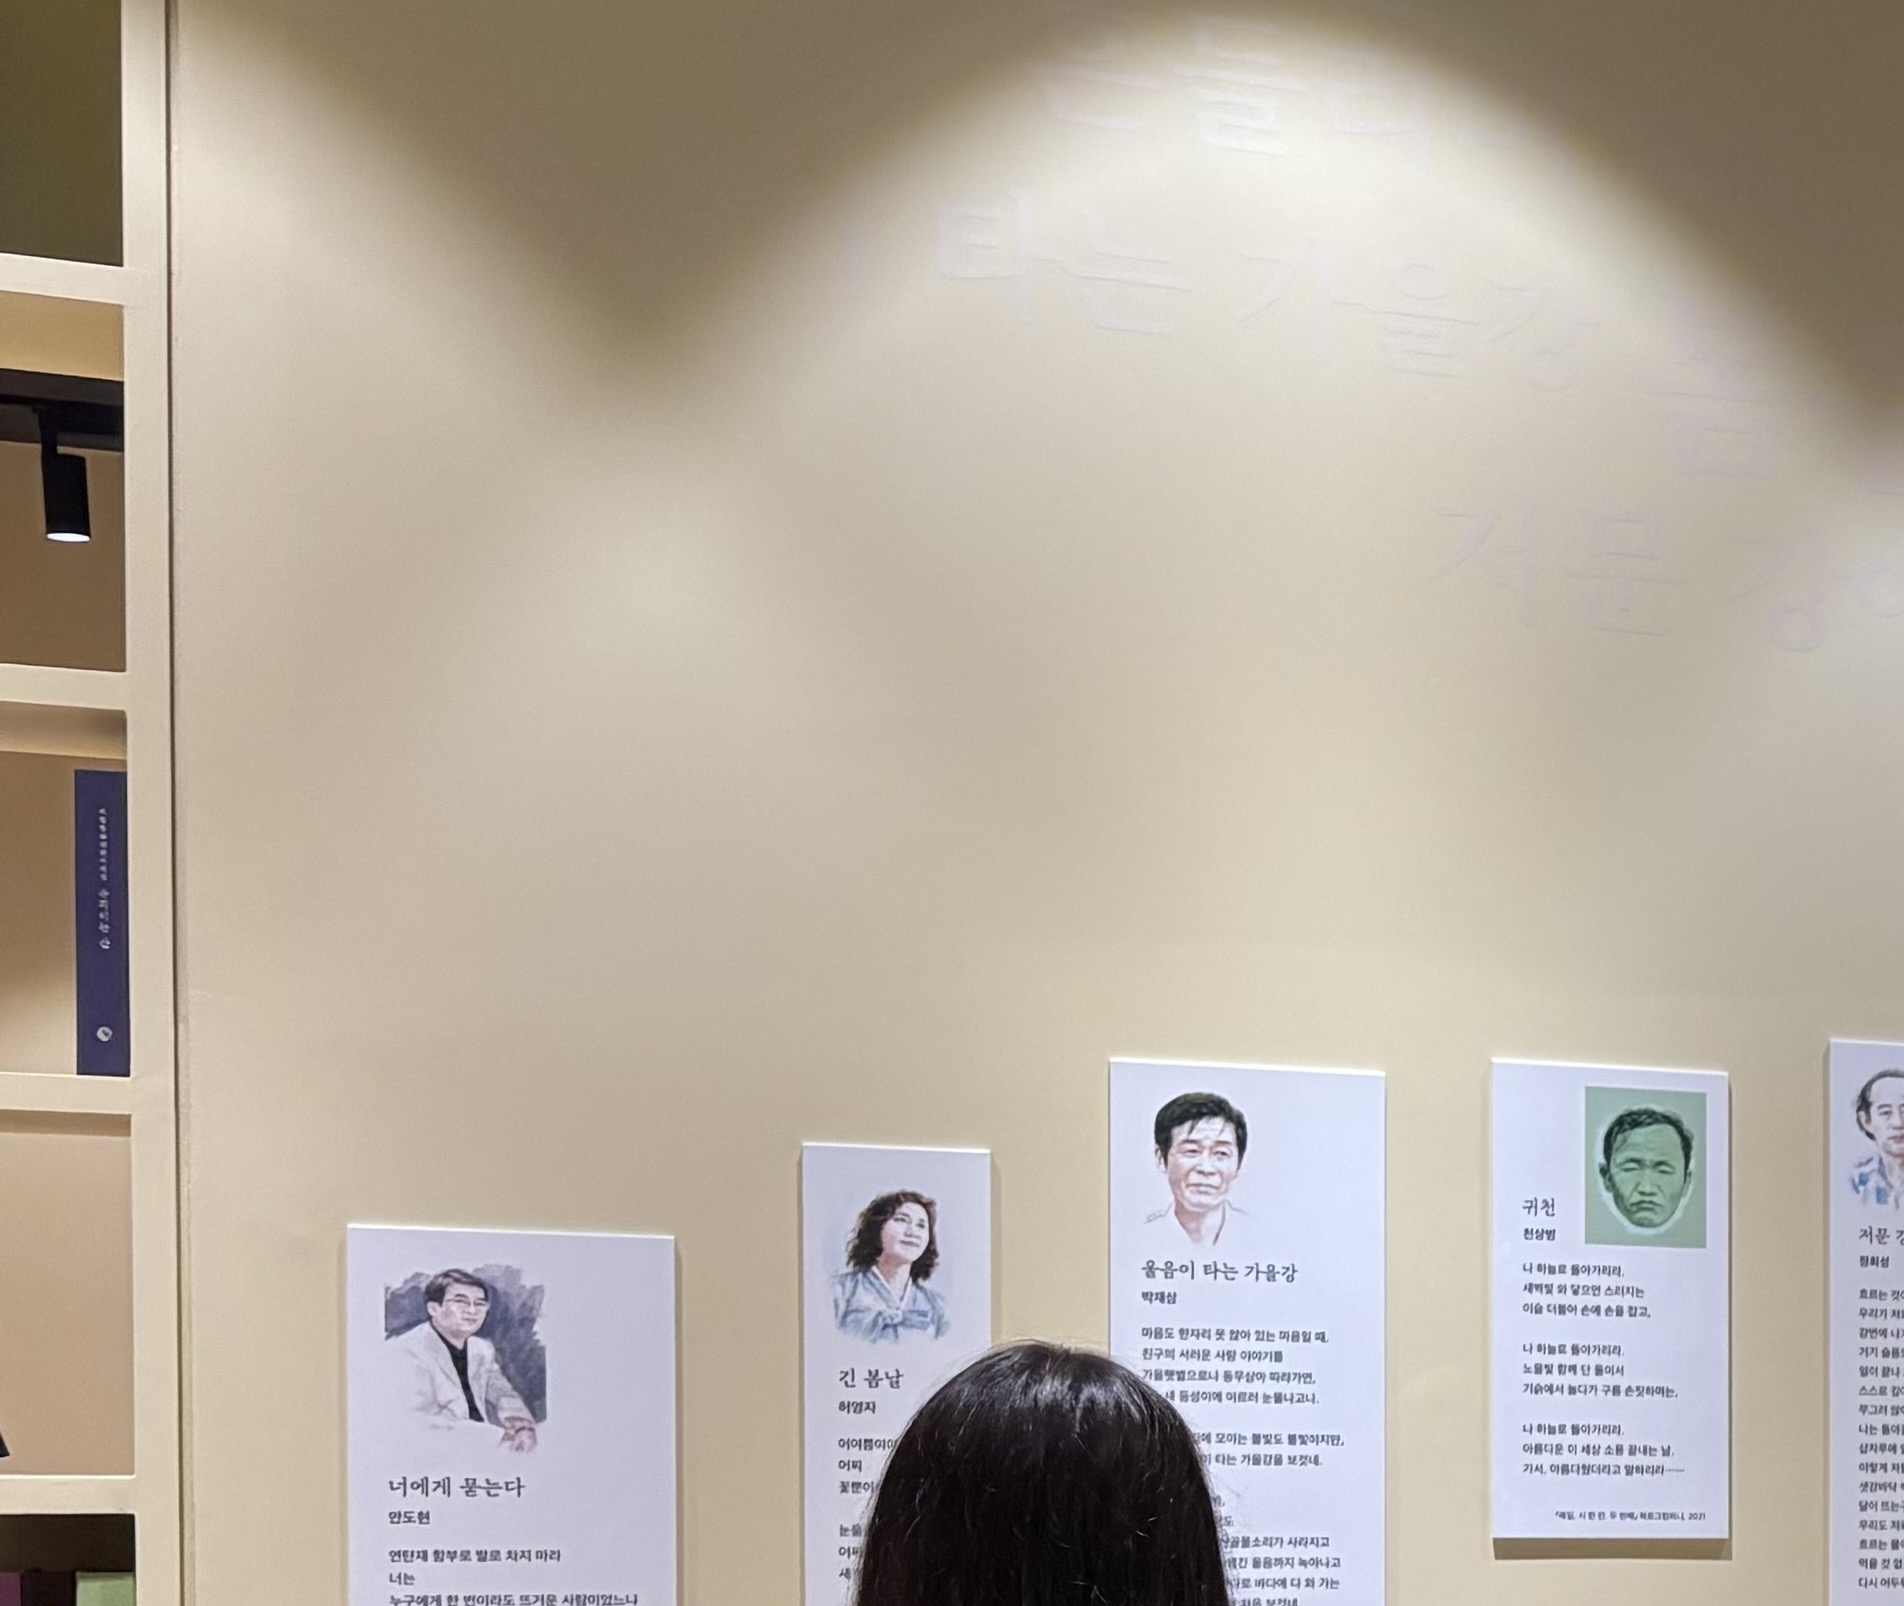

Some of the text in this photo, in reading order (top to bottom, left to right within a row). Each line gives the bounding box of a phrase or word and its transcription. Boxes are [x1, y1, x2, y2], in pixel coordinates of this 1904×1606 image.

[1522, 1196, 1556, 1218] 귀천
[1858, 1225, 1891, 1246] 저문
[1141, 1259, 1299, 1284] 울음이 타는 가을강
[1522, 1262, 1534, 1275] 나
[1536, 1263, 1568, 1276] 하늘로
[1141, 1291, 1178, 1305] 박재삼
[1580, 1304, 1602, 1317] 손에
[1604, 1304, 1625, 1318] 손을
[1141, 1326, 1175, 1340] 마음도
[1278, 1330, 1312, 1344] 마음일
[1142, 1347, 1176, 1361] 친구의
[1179, 1348, 1211, 1362] 서러운
[1239, 1350, 1284, 1364] 이야기를
[1522, 1342, 1534, 1355] 나
[1536, 1343, 1568, 1356] 하늘로
[1580, 1364, 1591, 1377] 단
[1594, 1363, 1625, 1377] 둘이서
[839, 1367, 905, 1390] 긴 봄날
[1601, 1384, 1622, 1397] 구름
[1522, 1423, 1534, 1436] 나
[1536, 1423, 1568, 1436] 하늘로
[1522, 1442, 1564, 1456] 아름다운
[1567, 1444, 1578, 1456] 이
[1581, 1443, 1602, 1457] 세상
[1214, 1453, 1237, 1466] 타는
[1523, 1463, 1547, 1475] 가서,
[388, 1476, 527, 1499] 너에게 묻는다
[388, 1510, 431, 1526] 안도현
[475, 1549, 502, 1563] 발로
[505, 1549, 532, 1563] 차지
[535, 1549, 561, 1563] 마라
[389, 1572, 416, 1586] 너는
[1290, 1577, 1302, 1590] 다
[1318, 1577, 1340, 1590] 가는
